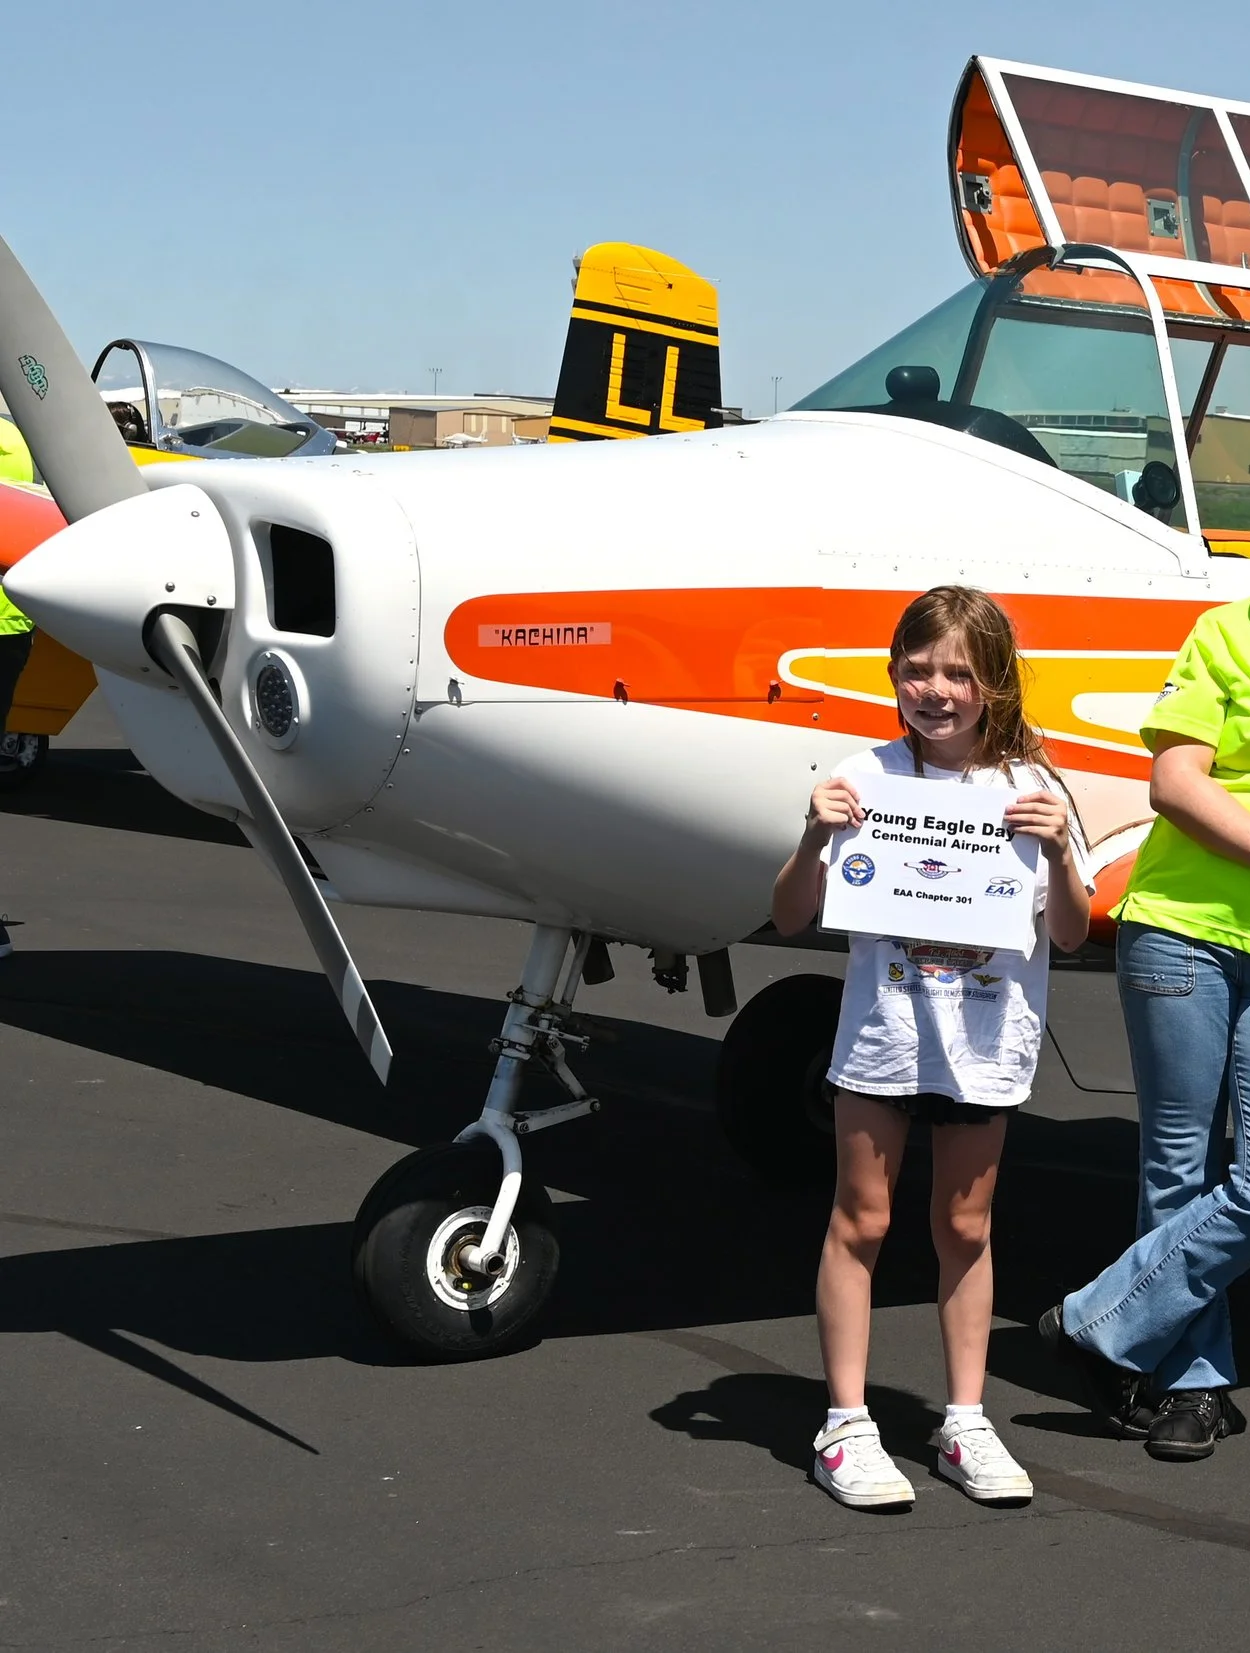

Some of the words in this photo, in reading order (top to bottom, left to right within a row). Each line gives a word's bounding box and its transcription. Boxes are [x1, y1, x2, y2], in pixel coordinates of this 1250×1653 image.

[605, 332, 706, 432] LL
[861, 807, 917, 830] Young
[923, 815, 975, 835] Eagle
[981, 823, 1015, 842] Day
[871, 829, 947, 847] Centennial
[951, 839, 1000, 853] Airport
[893, 888, 913, 897] EAA
[915, 891, 953, 902] Chapter
[955, 896, 972, 904] 301
[985, 885, 1015, 896] EAA
